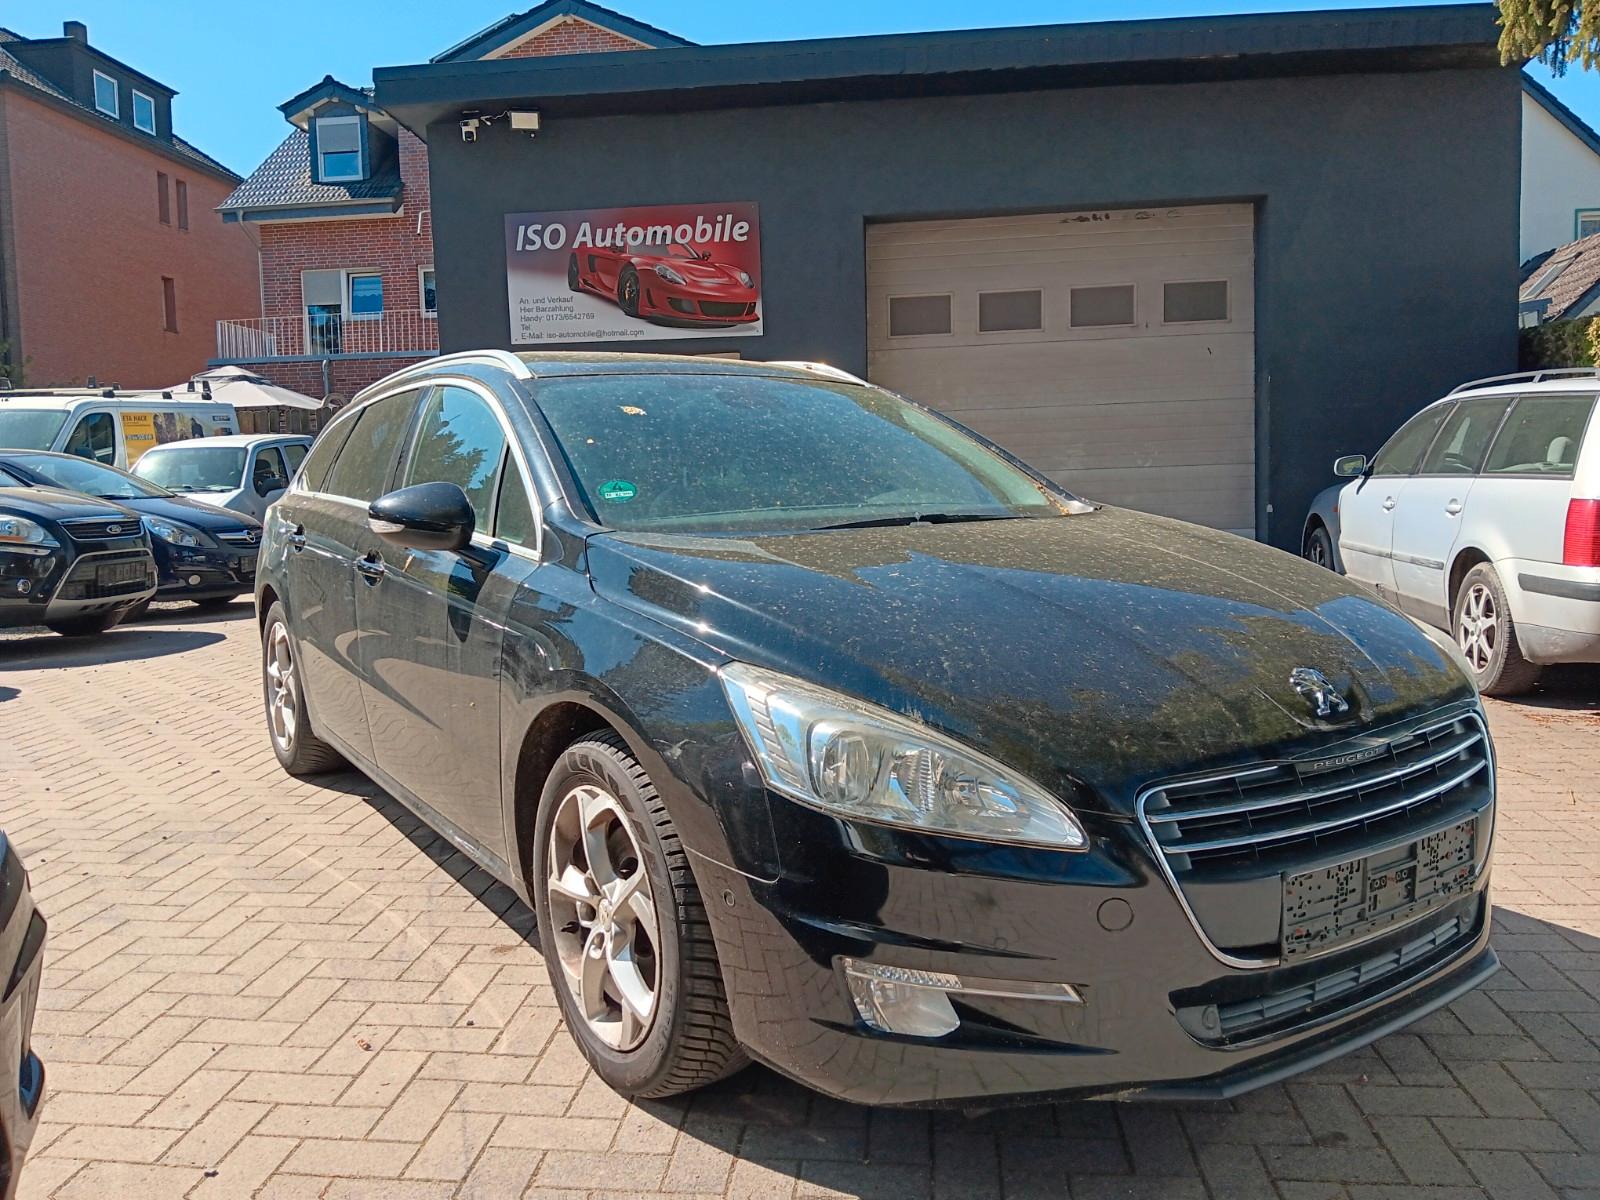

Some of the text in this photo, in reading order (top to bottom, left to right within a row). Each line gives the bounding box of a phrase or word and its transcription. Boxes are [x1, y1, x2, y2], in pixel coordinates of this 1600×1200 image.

[516, 214, 750, 251] ISO Automobile
[535, 305, 574, 313] Barzahlung
[1313, 748, 1379, 770] PEUGEOT
